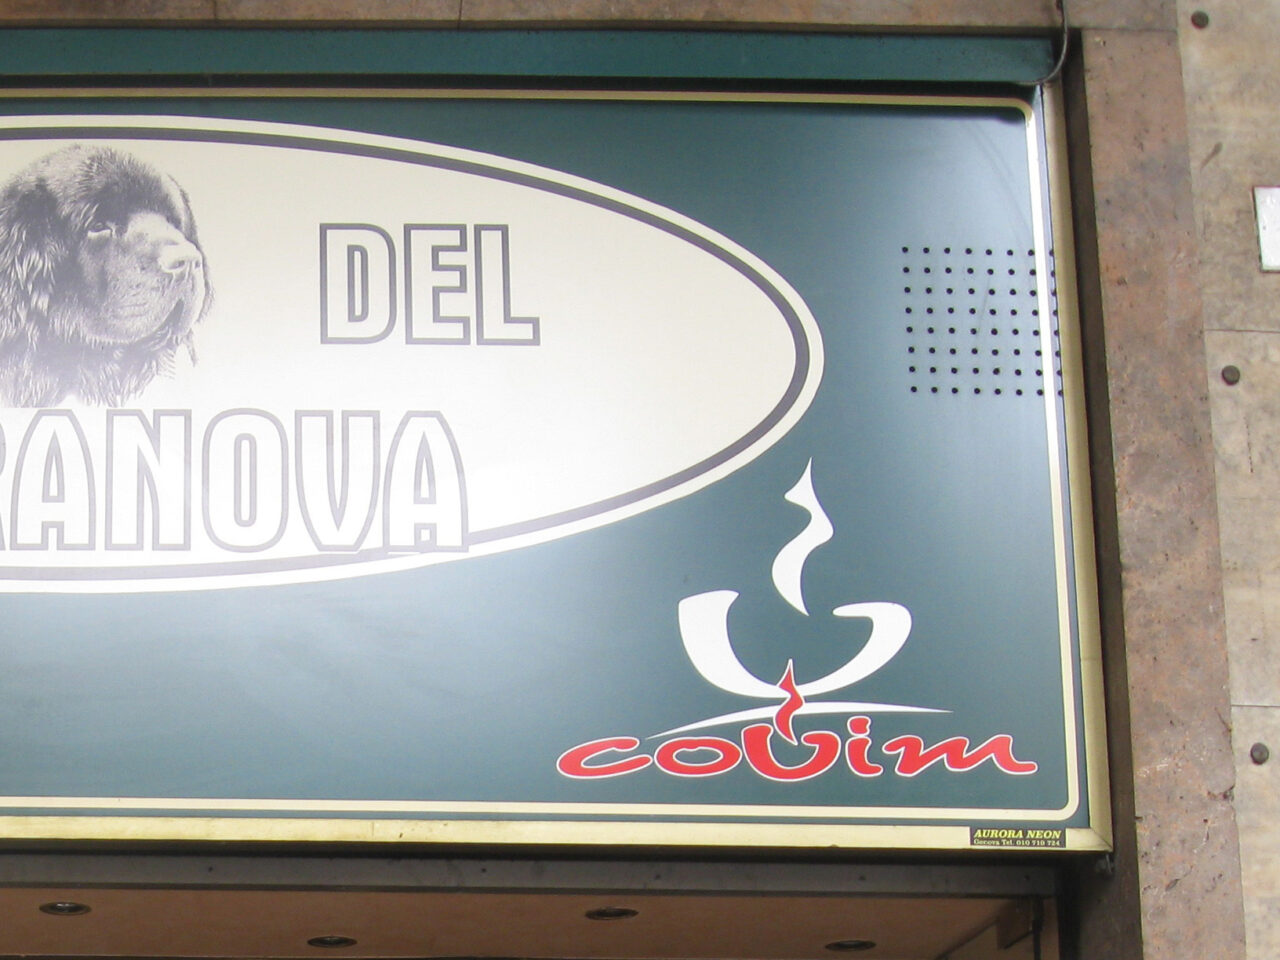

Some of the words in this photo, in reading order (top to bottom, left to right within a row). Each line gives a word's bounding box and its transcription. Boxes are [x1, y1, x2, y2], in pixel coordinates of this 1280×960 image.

[319, 222, 541, 346] DEL
[556, 712, 1038, 782] covim
[973, 829, 1024, 838] AURORA
[1026, 830, 1062, 839] NEON
